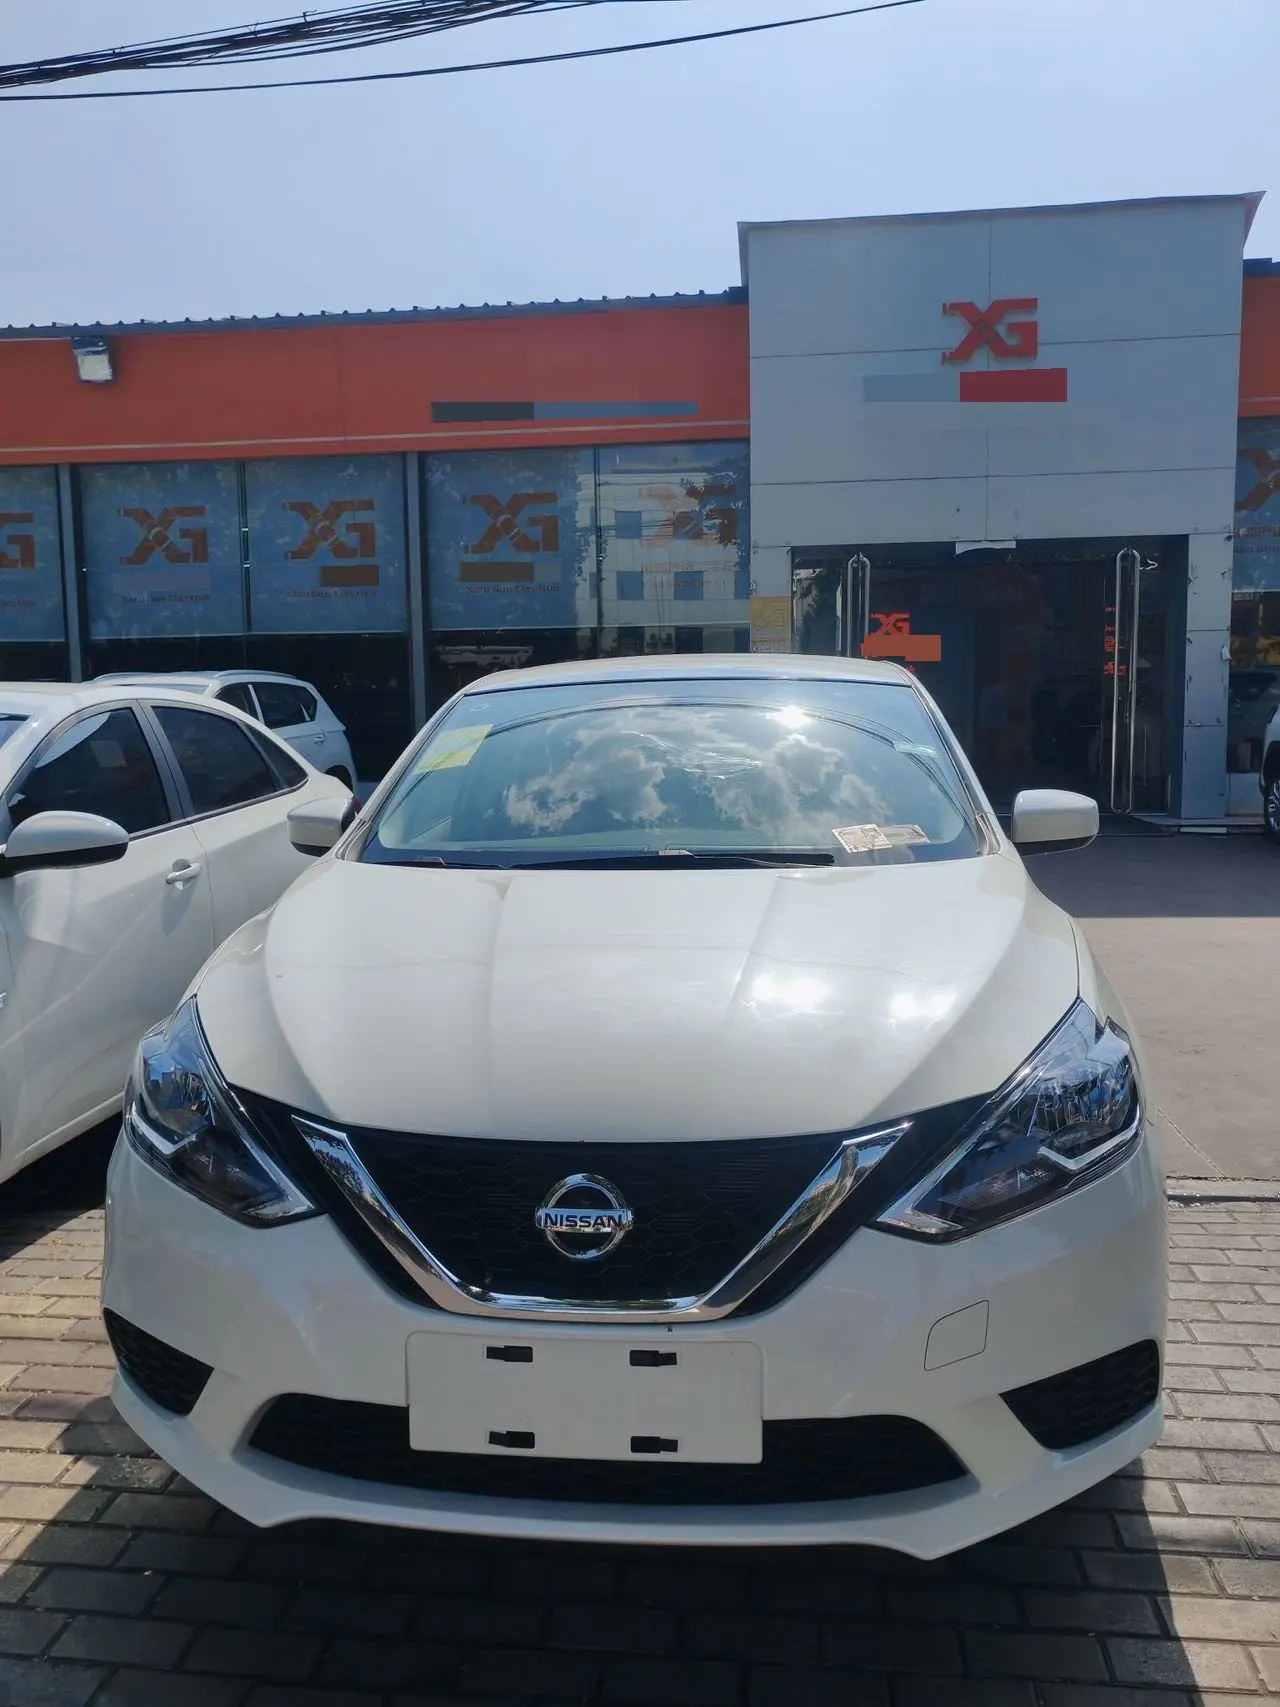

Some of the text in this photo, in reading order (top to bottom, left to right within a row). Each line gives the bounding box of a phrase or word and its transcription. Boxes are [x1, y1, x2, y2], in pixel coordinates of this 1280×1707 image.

[942, 298, 1039, 364] XG
[118, 506, 209, 566] XG
[283, 500, 376, 560] XG
[465, 491, 559, 554] XG
[544, 1212, 623, 1229] NISSAN
